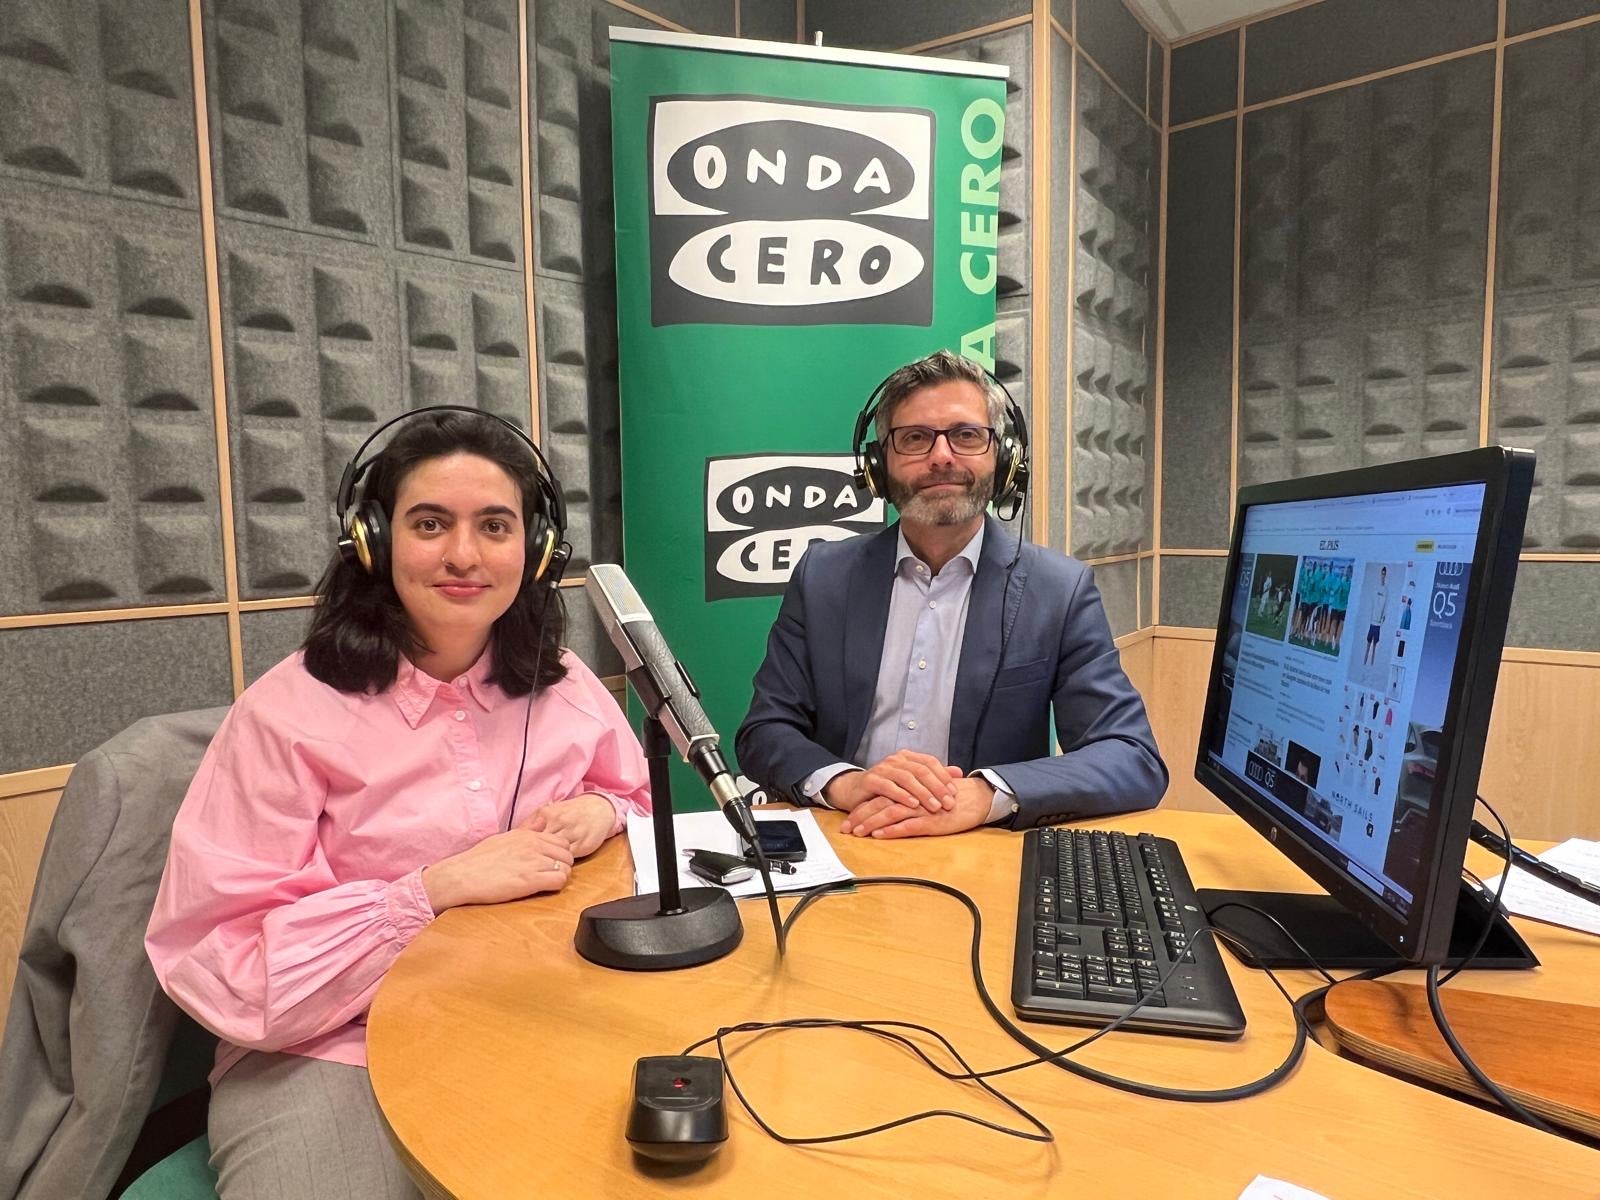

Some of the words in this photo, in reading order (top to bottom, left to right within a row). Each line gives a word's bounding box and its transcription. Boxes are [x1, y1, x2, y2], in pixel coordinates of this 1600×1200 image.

[692, 144, 891, 194] ONDA
[960, 98, 1006, 295] CERO
[706, 233, 892, 286] CERO
[732, 484, 858, 514] ONDA
[740, 537, 826, 572] CE
[1433, 590, 1458, 619] Q5
[1264, 771, 1275, 788] Q5
[1331, 791, 1353, 808] NORTH
[1354, 804, 1374, 822] SAILS
